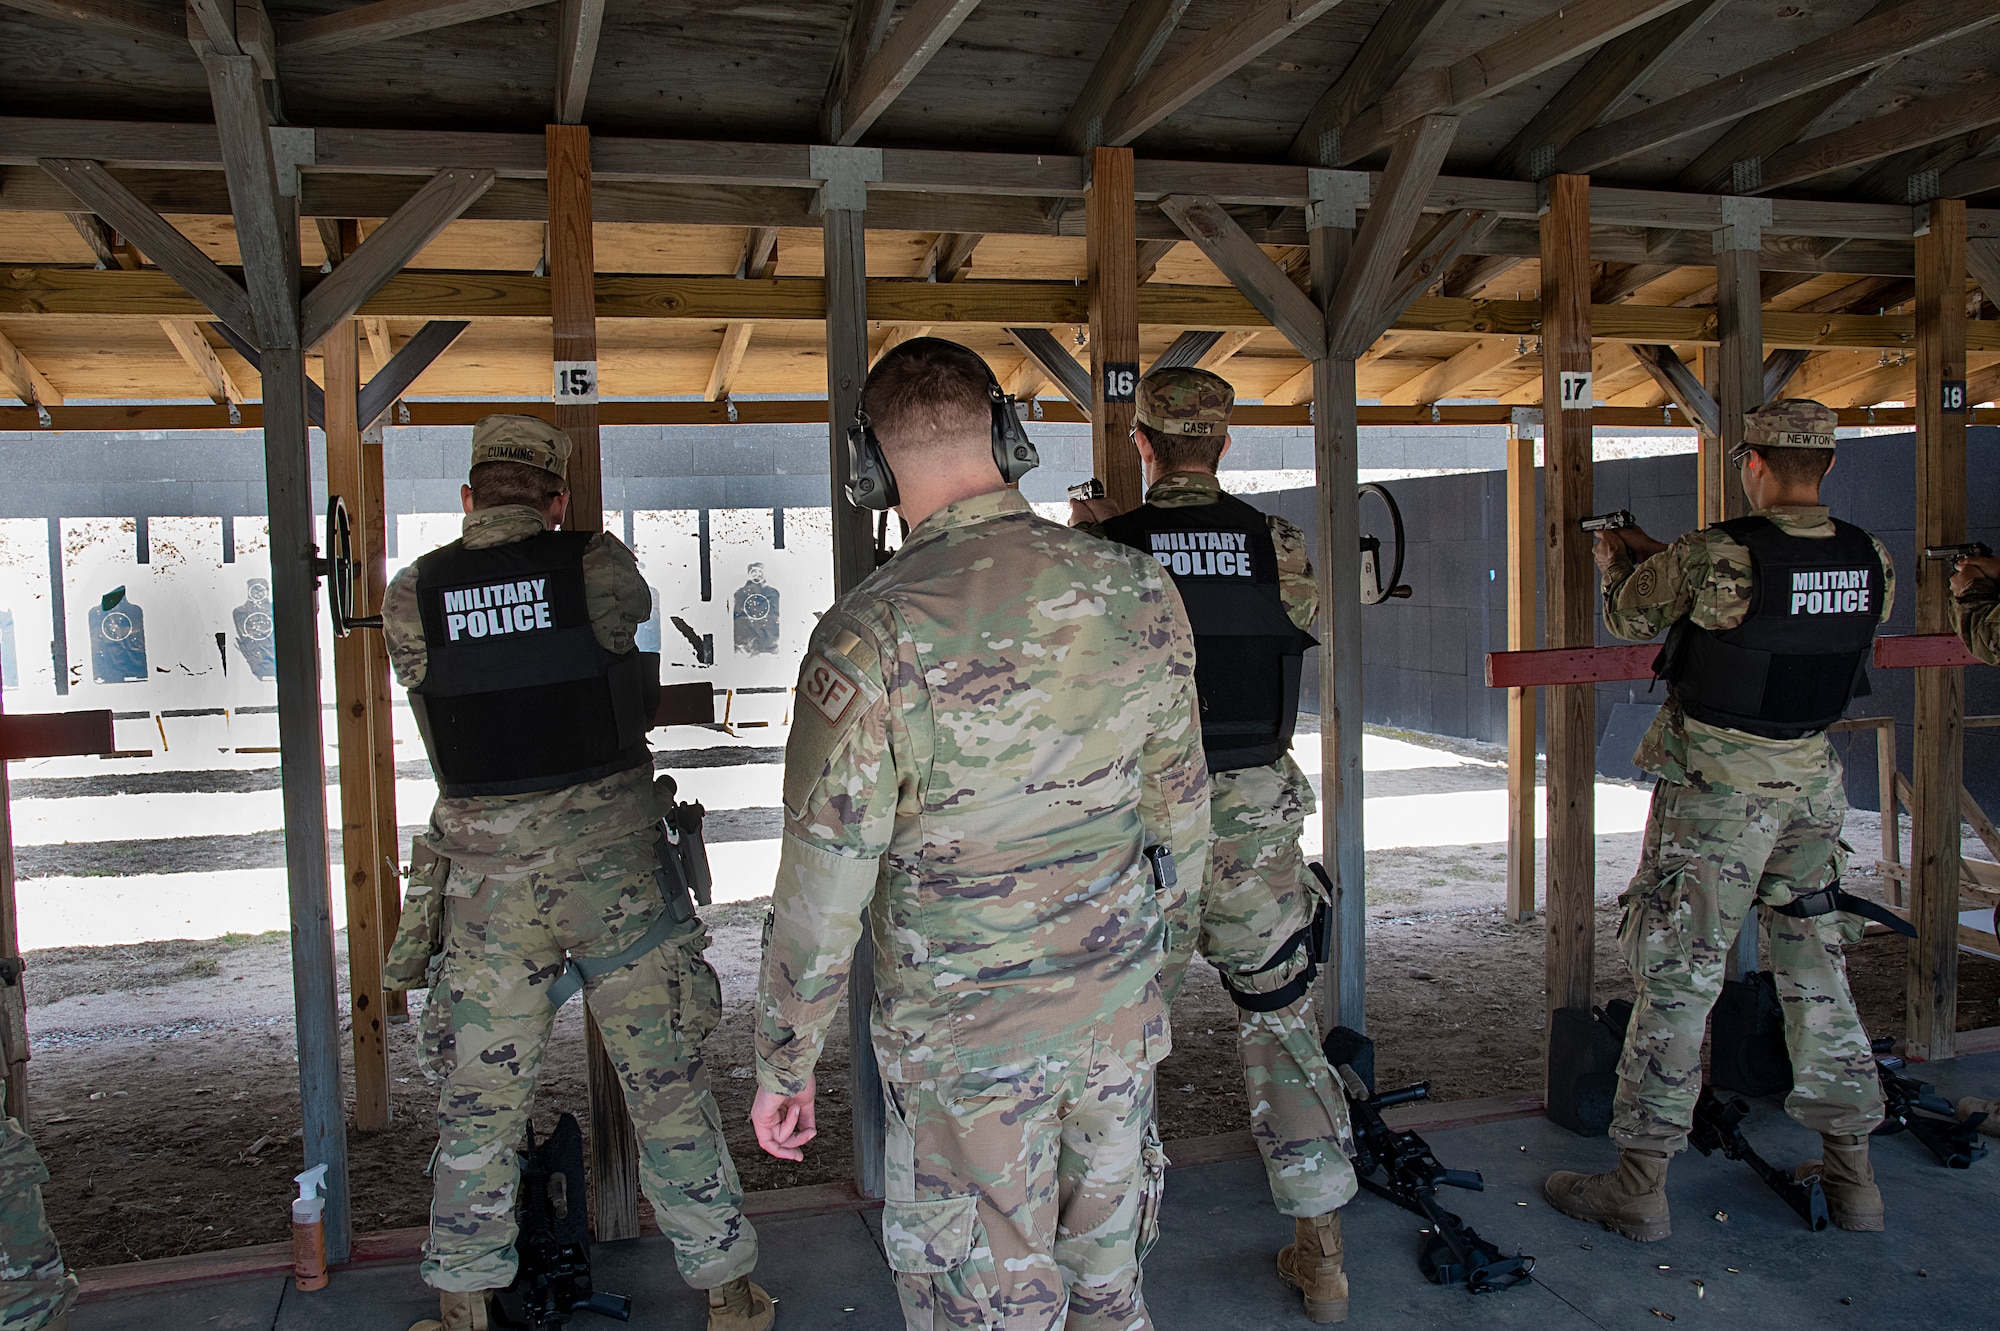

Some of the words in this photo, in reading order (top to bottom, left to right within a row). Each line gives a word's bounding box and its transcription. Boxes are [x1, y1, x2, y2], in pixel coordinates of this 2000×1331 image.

[560, 369, 588, 395] 15
[1108, 370, 1134, 396] 16
[1564, 378, 1587, 400] 17
[1943, 386, 1962, 408] 18
[1183, 421, 1215, 434] CASEY
[1786, 433, 1830, 445] NEWTON
[487, 446, 534, 461] CUMMING
[1150, 532, 1246, 551] MILITARY
[1792, 570, 1869, 591] MILITARY
[444, 579, 545, 613] MILITARY
[1791, 589, 1869, 615] POLICE
[447, 602, 552, 641] POLICE
[807, 667, 848, 706] SF
